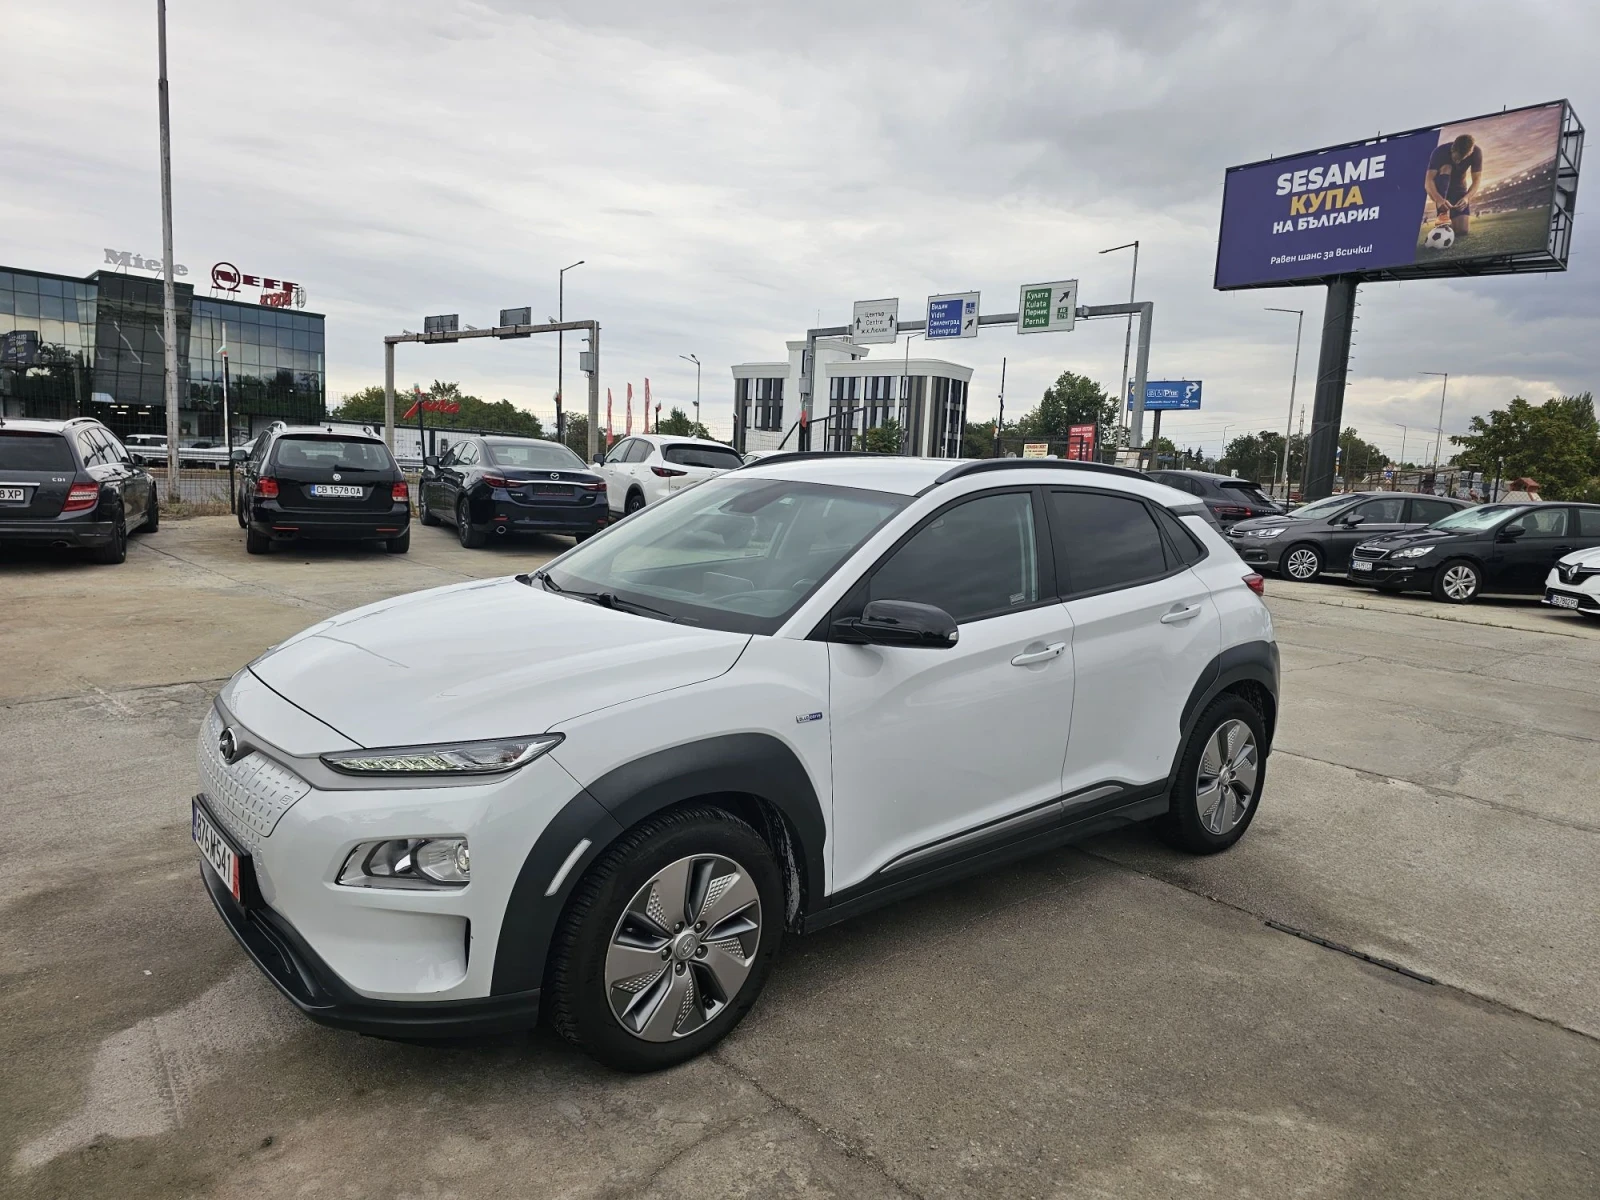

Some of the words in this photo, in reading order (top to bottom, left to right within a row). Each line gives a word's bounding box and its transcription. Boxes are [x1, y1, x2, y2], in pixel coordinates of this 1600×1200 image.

[1276, 155, 1387, 195] SESAME
[1290, 185, 1364, 216] КУПА
[1272, 220, 1294, 234] НА
[1297, 206, 1380, 230] БЪЛГАРИЯ
[104, 248, 188, 276] Miee
[1270, 254, 1297, 265] Равен
[1298, 251, 1322, 261] шанс
[1323, 249, 1334, 260] за
[1335, 244, 1373, 257] всички!
[215, 268, 300, 292] NEFF
[1026, 291, 1049, 300] Кулата
[1026, 301, 1047, 309] Kulata
[1025, 309, 1048, 317] Перник
[1025, 317, 1046, 326] Pernik
[929, 327, 958, 336] Svilengrad
